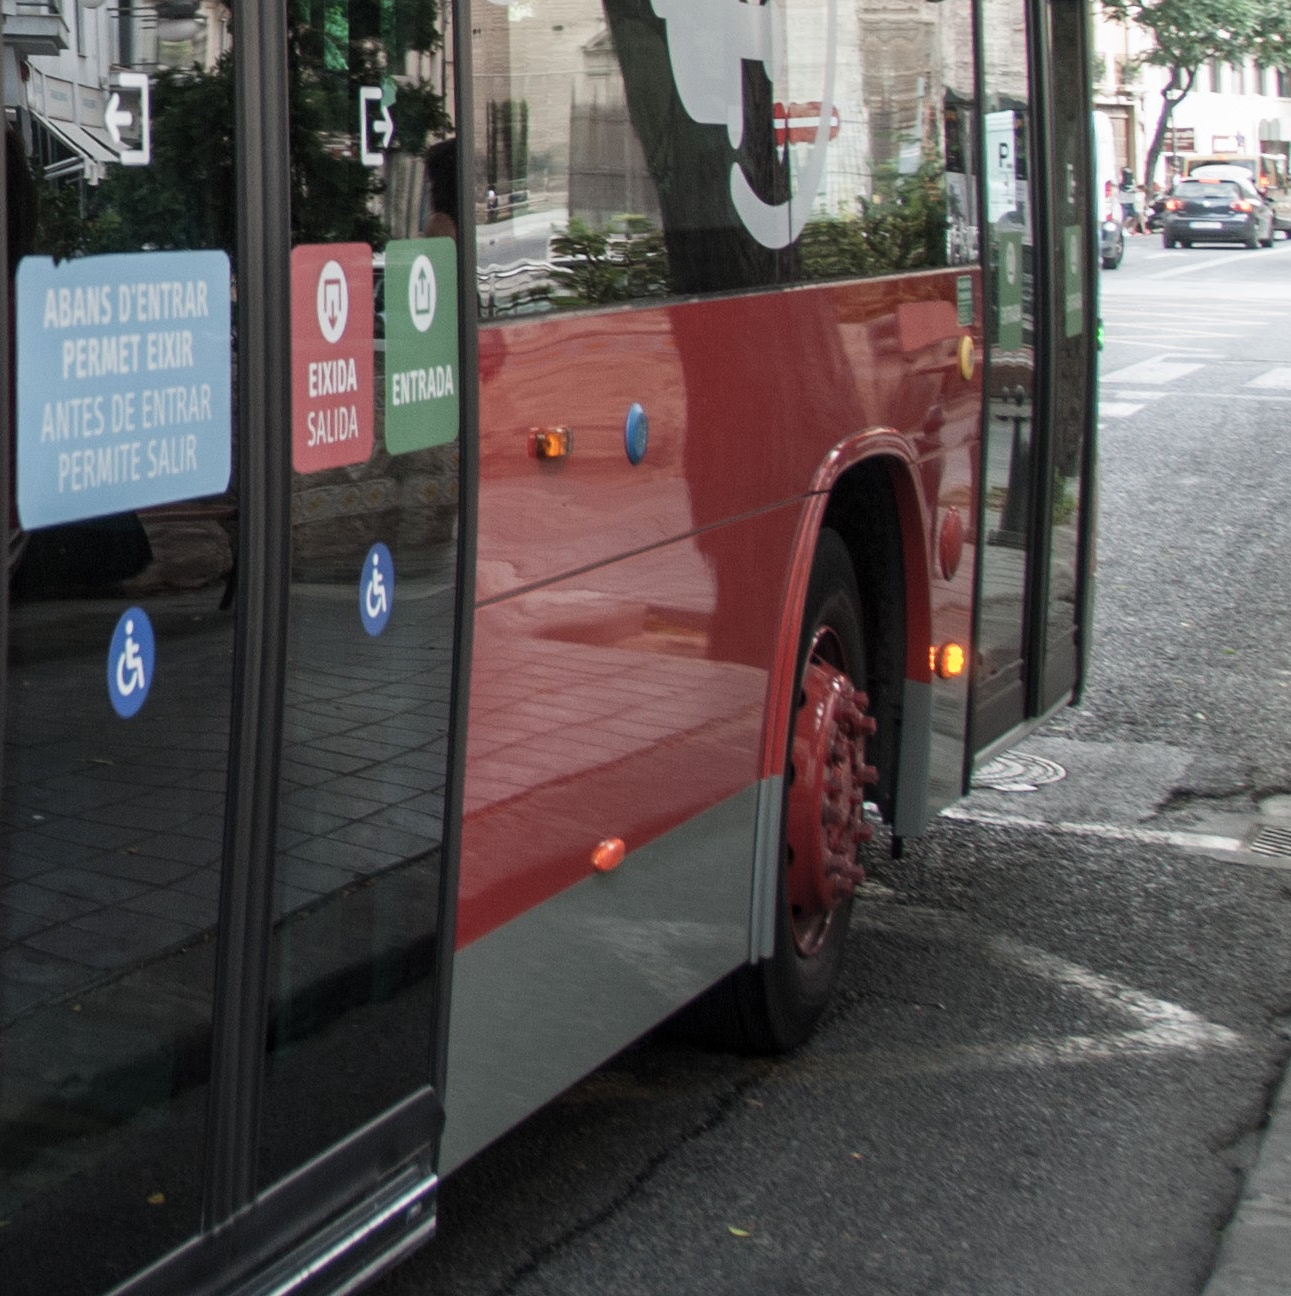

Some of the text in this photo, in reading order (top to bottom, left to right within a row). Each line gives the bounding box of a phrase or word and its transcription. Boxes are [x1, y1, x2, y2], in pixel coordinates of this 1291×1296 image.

[43, 280, 209, 329] ABANS D'ENTRAR
[62, 330, 194, 379] PERMET EIXIR
[308, 357, 358, 398] EIXIDA
[392, 364, 454, 407] ENTRADA
[41, 383, 212, 443] ANTES DE ENTRAR
[307, 405, 359, 447] SALIDA
[58, 433, 197, 493] PERMITE SALIR
